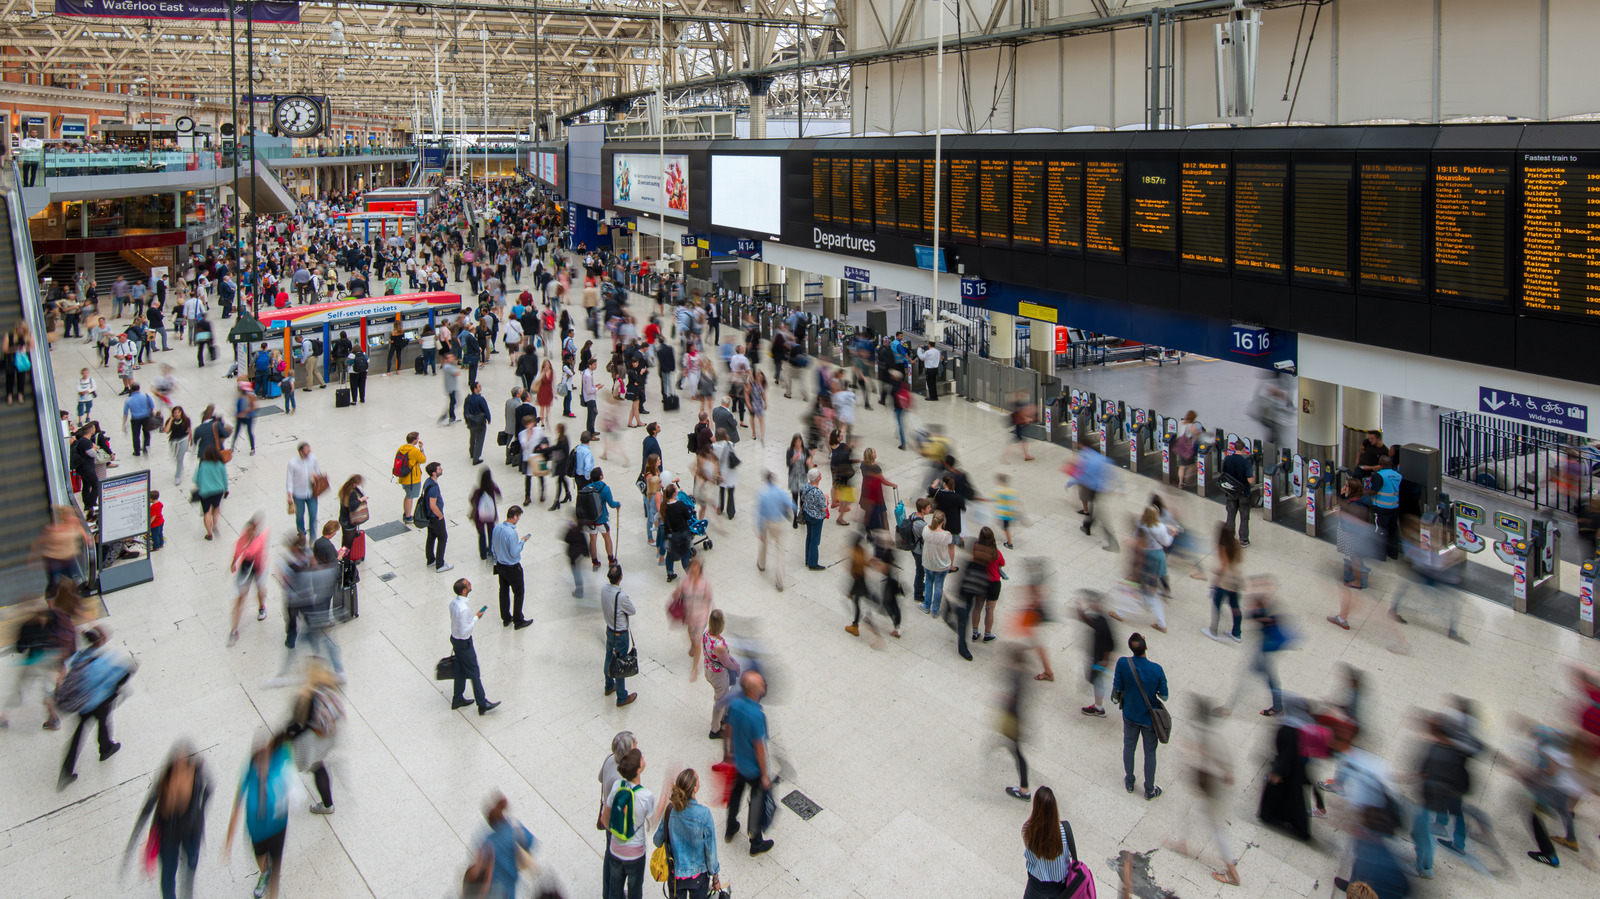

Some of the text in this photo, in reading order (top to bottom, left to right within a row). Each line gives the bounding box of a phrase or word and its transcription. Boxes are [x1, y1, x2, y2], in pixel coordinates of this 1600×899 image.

[103, 0, 157, 11] Waterloo
[159, 2, 184, 12] East
[686, 237, 695, 245] 13
[745, 241, 755, 251] 14
[813, 227, 876, 253] Departures
[1524, 249, 1595, 260] Southampton Central
[1311, 267, 1324, 275] West
[1327, 269, 1345, 277] Trains
[1380, 274, 1395, 282] West
[1524, 272, 1553, 280] Surbiton
[962, 282, 973, 295] 15
[975, 283, 987, 295] 15
[1523, 284, 1560, 292] Winchester
[327, 305, 397, 319] Self-service tickets
[1233, 331, 1253, 350] 16
[1257, 332, 1270, 350] 16
[1528, 412, 1563, 426] Wide gate
